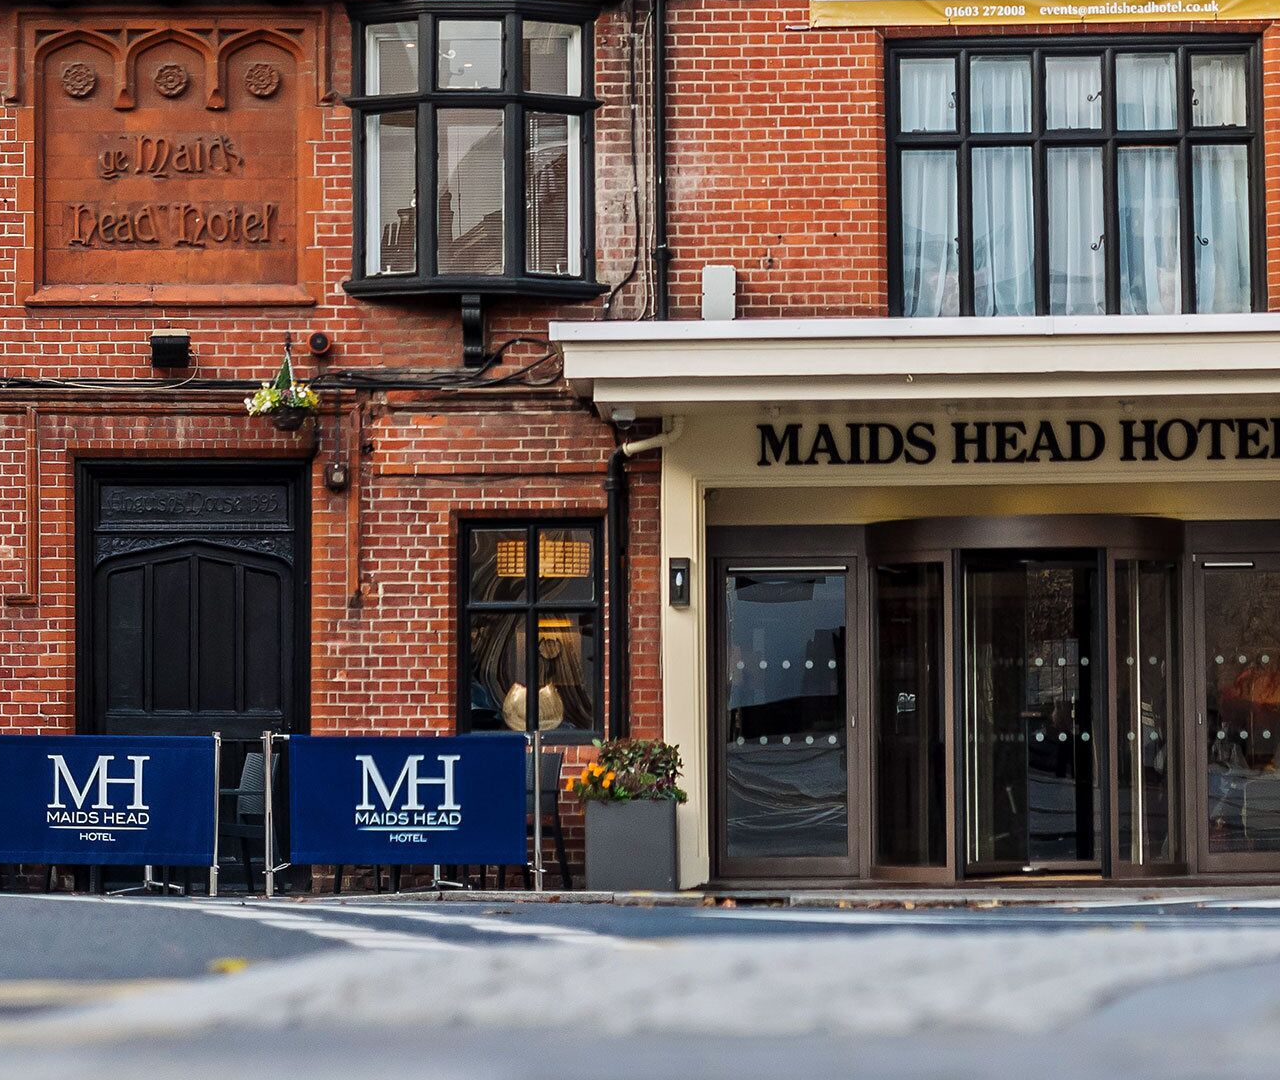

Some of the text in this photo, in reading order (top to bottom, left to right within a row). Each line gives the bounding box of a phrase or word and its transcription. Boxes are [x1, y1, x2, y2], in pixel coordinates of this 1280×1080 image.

[944, 0, 1219, 17] 01603 272008 events@maidsheadhotel.co.uk
[756, 422, 937, 467] MAIDS
[951, 419, 1106, 464] HEAD
[47, 755, 150, 809] MH
[355, 755, 461, 811] MH
[46, 811, 150, 824] MAIDS HEAD
[355, 812, 461, 825] MAIDS HEAD
[79, 833, 116, 841] HOTEL
[389, 833, 427, 842] HOTEL
